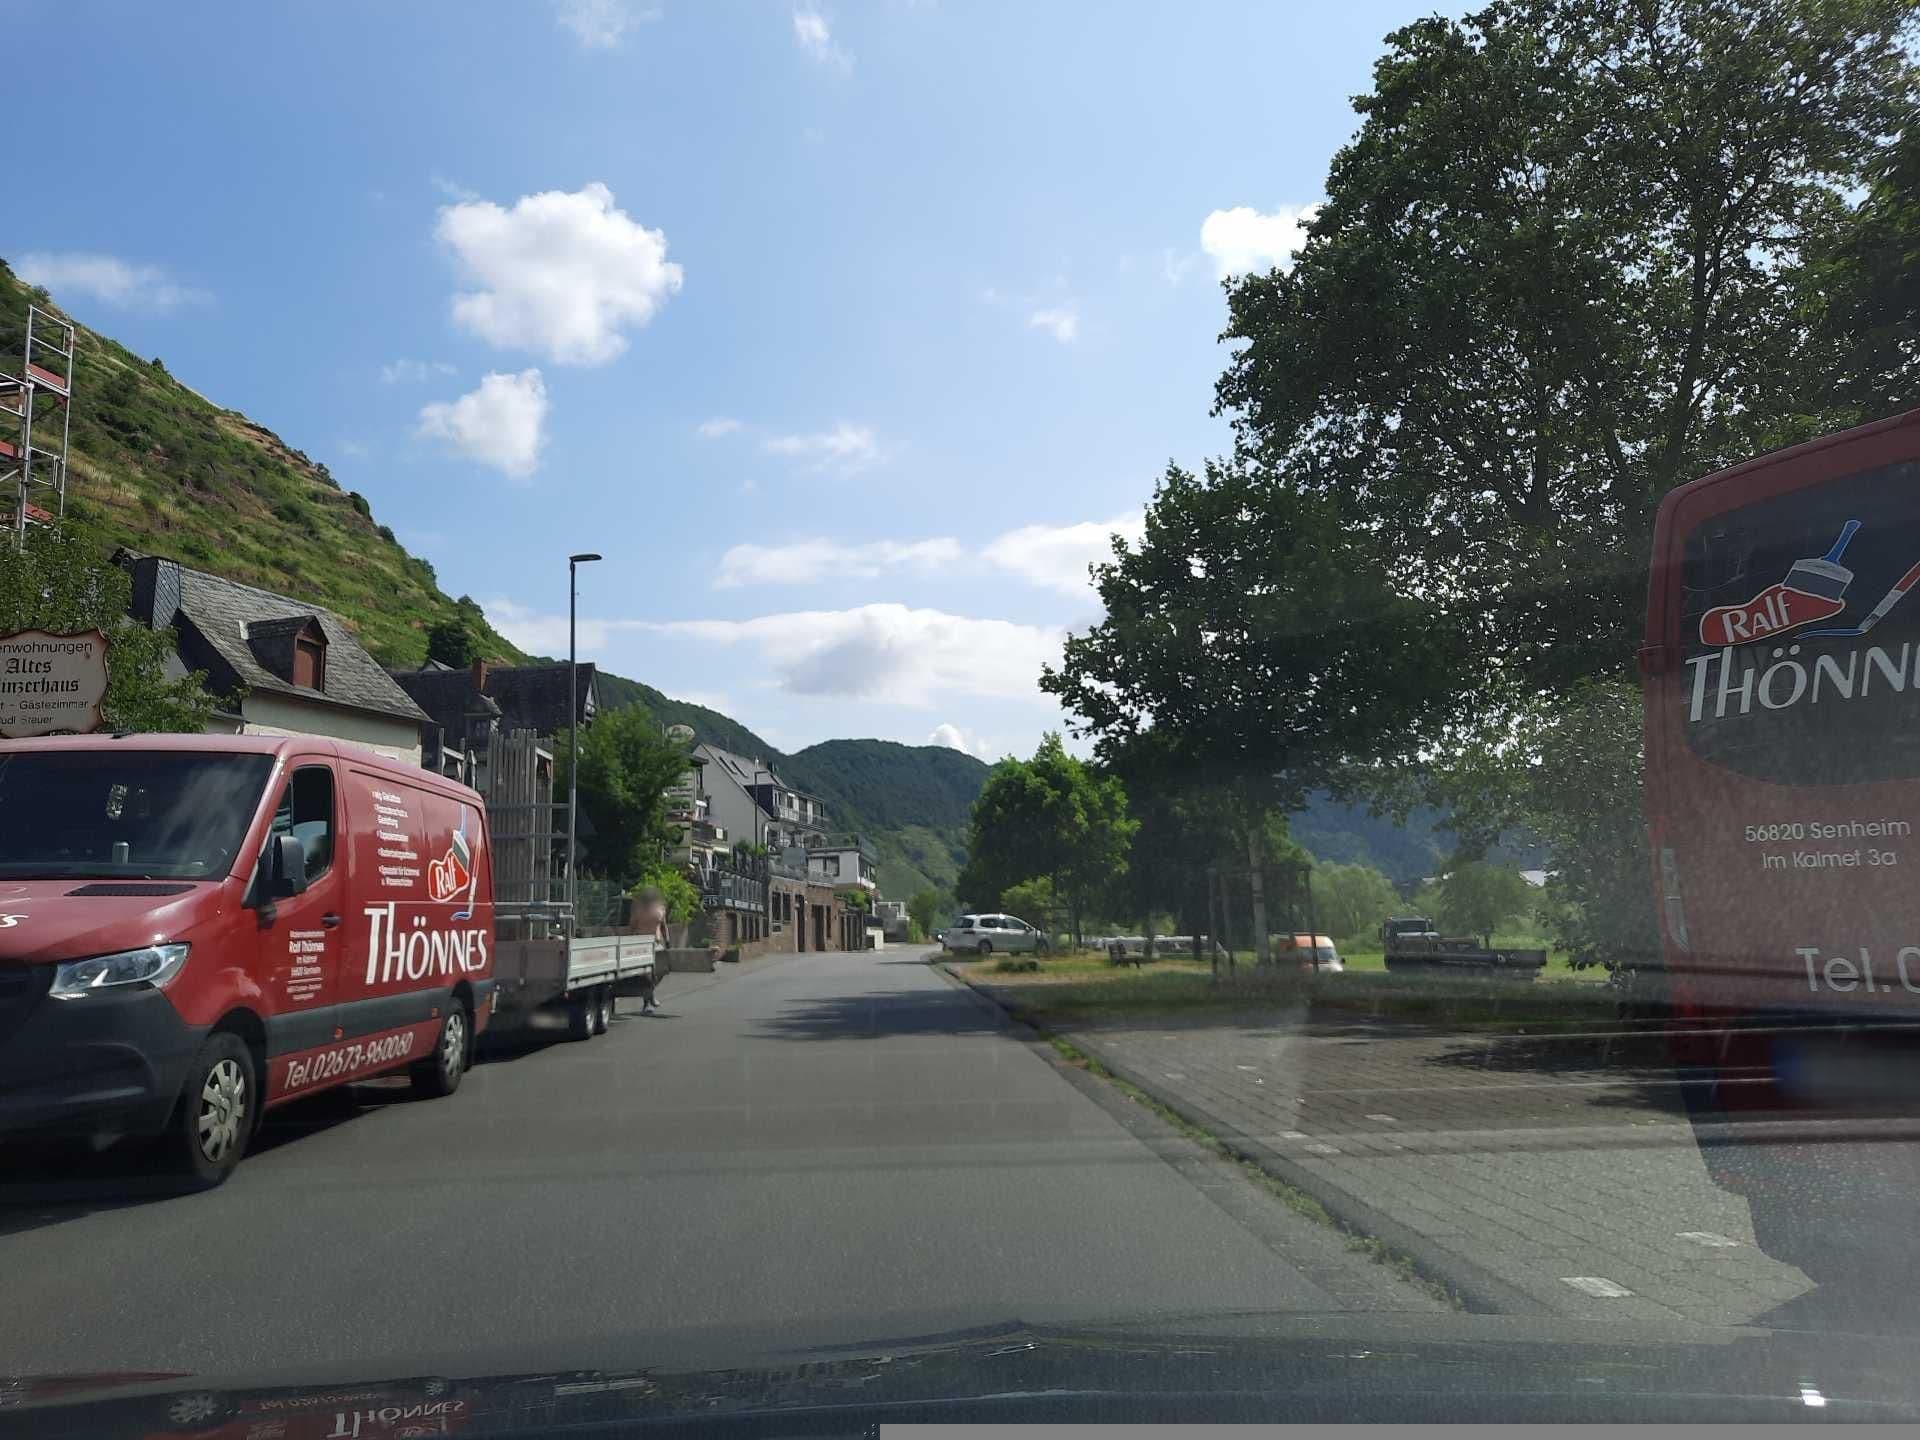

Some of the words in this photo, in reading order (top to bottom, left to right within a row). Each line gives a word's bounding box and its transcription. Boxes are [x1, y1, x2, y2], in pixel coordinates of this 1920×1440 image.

[0, 641, 93, 655] nwohnungen
[5, 657, 52, 674] Altes
[0, 677, 80, 695] inzerhaus
[1684, 643, 1920, 722] THÖNN
[0, 715, 16, 725] udi
[1745, 823, 1804, 842] 56820
[1810, 818, 1911, 840] Senheim
[1763, 852, 1786, 869] Im
[1792, 849, 1861, 869] Kalmet
[1867, 849, 1897, 866] 3a
[364, 901, 487, 985] THÖNNES
